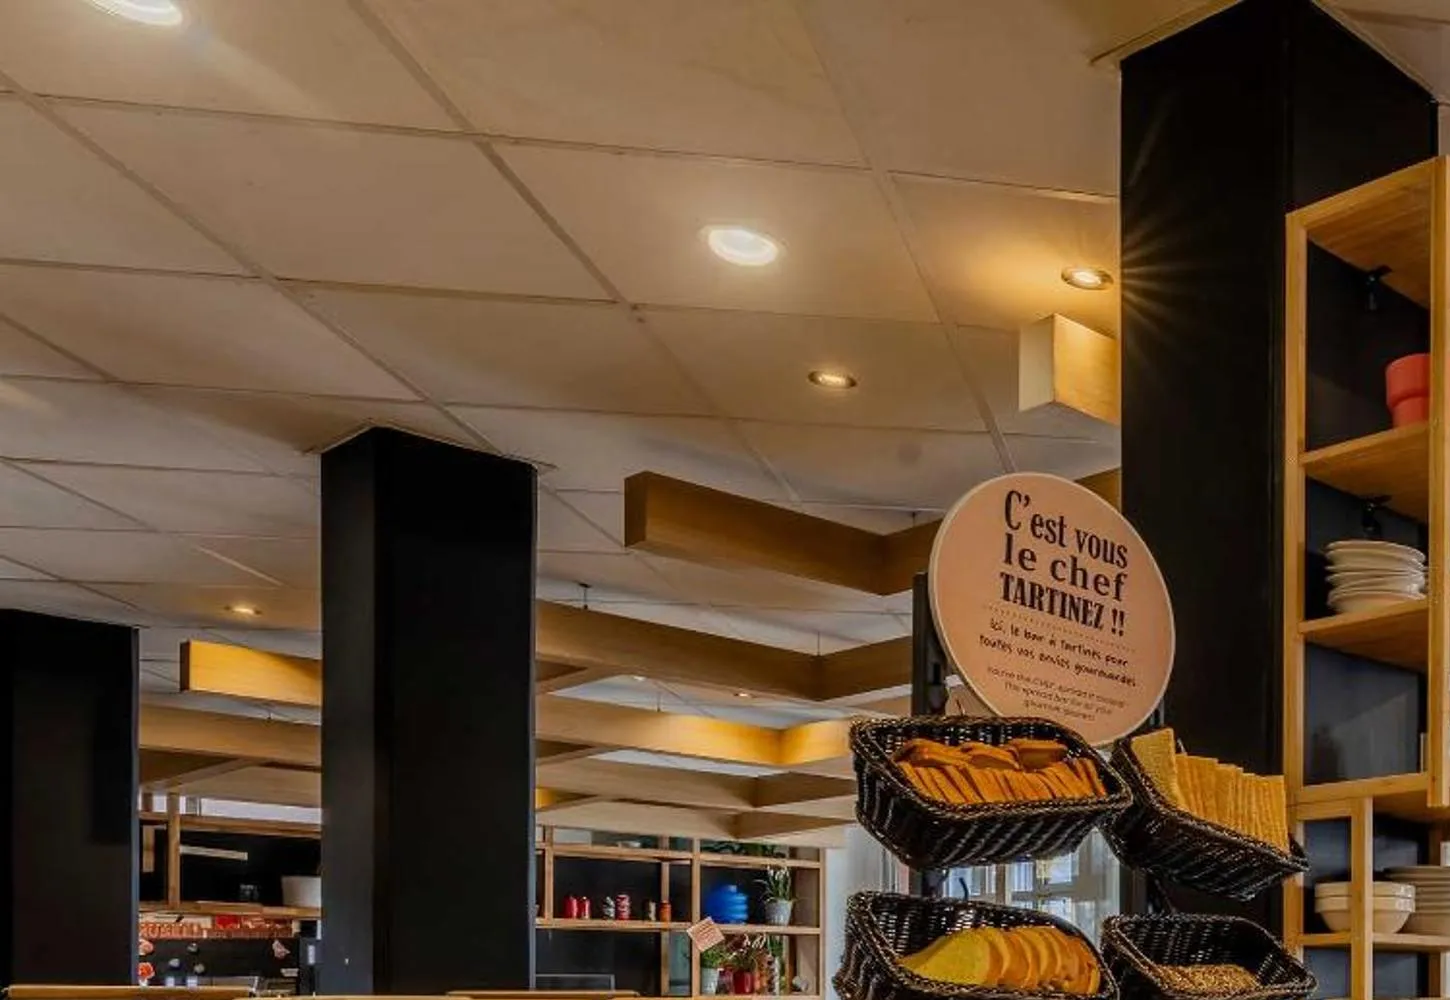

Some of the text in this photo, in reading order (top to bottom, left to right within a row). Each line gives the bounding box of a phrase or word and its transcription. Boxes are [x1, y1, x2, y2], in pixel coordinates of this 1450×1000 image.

[1004, 490, 1128, 569] C'est vous
[1004, 533, 1128, 602] le chef
[1000, 572, 1125, 637] TARTINEZ !!
[1010, 624, 1019, 636] le
[1023, 628, 1044, 641] bar
[1105, 655, 1128, 667] pour
[1016, 648, 1035, 659] vos
[1039, 653, 1070, 669] envies
